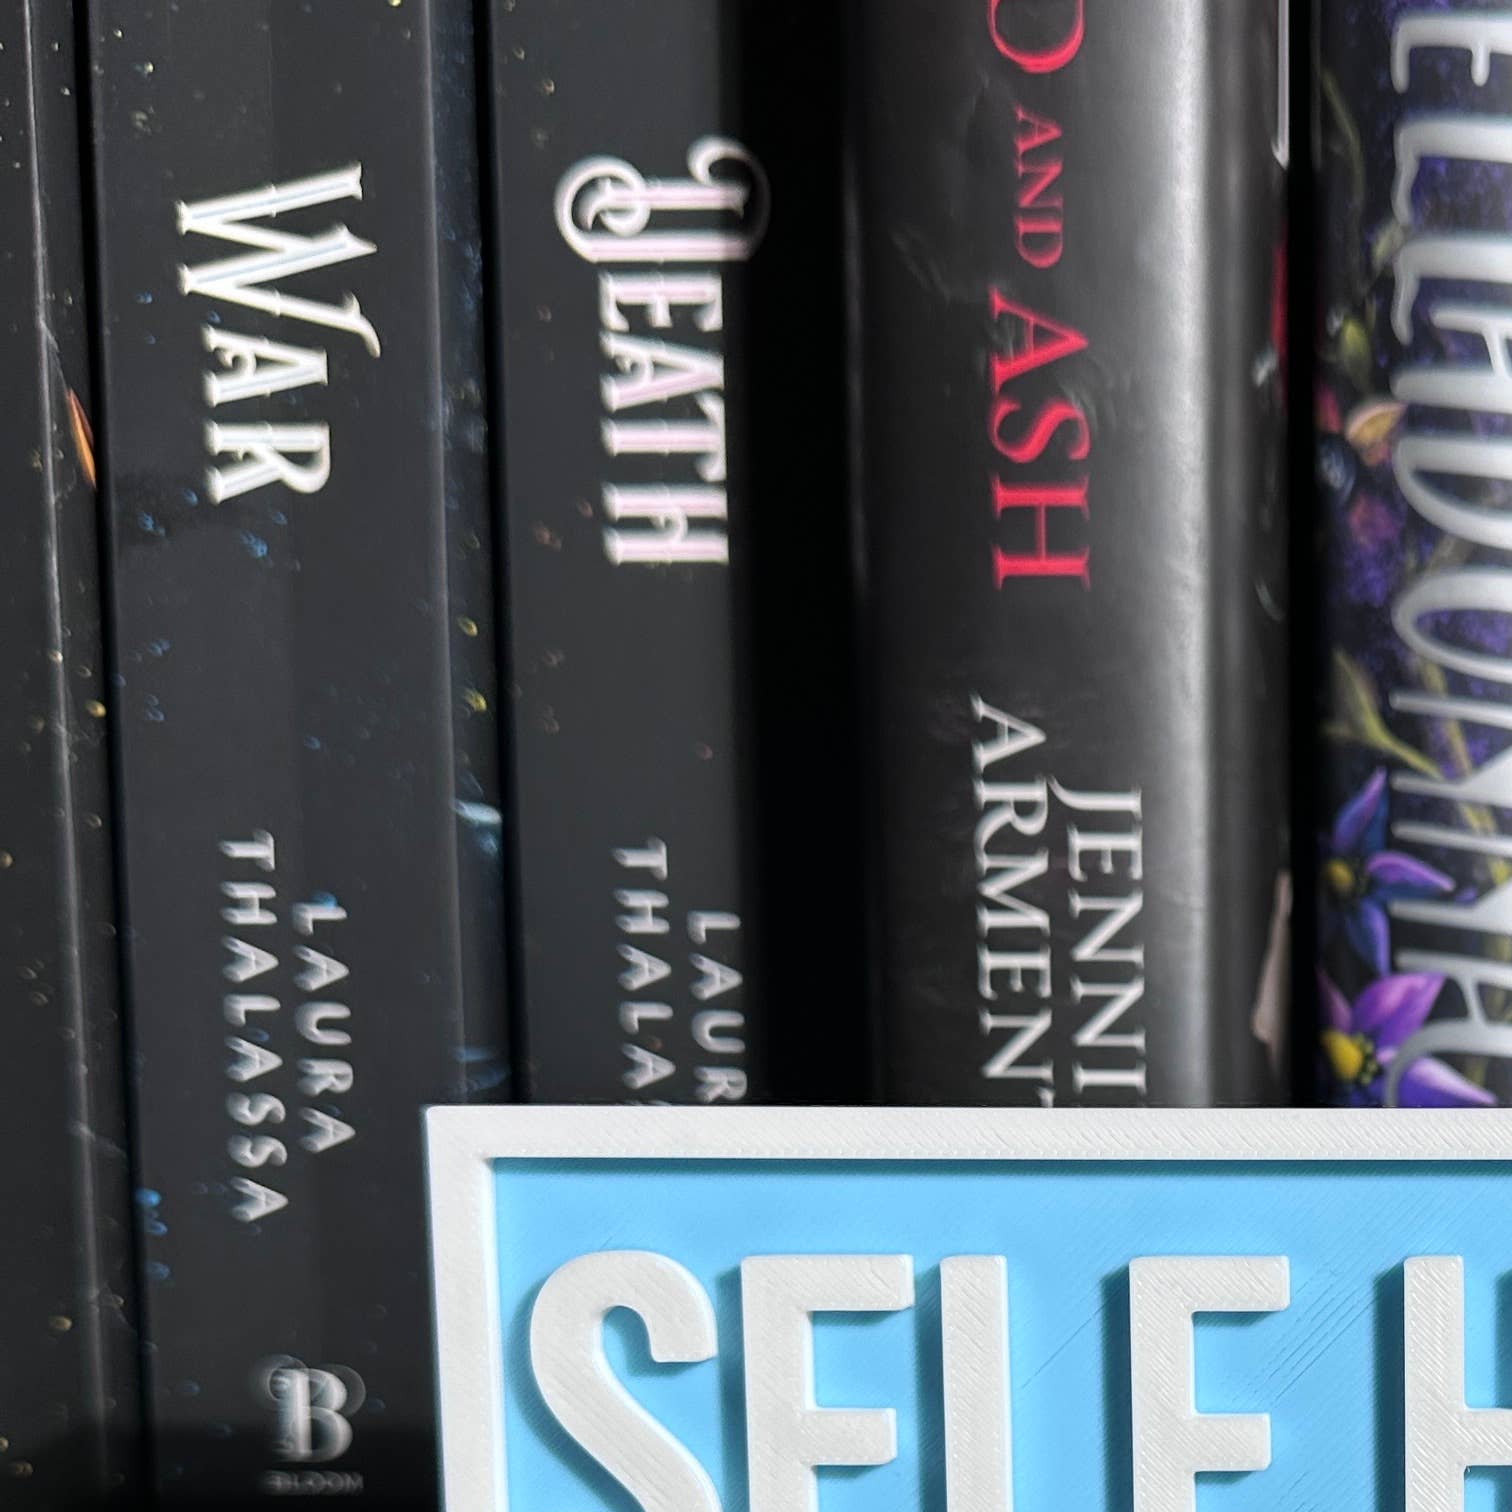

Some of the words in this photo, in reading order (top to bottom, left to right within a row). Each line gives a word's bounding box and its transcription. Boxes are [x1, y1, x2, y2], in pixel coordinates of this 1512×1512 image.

[176, 161, 383, 507] WAR
[1012, 102, 1065, 269] AND
[554, 135, 772, 568] DEATH
[987, 285, 1092, 591] ASH
[217, 829, 289, 1223] THALASSA
[290, 900, 356, 1155] LAURA
[612, 836, 677, 1106] THALA
[970, 690, 1055, 1108] ARMEN
